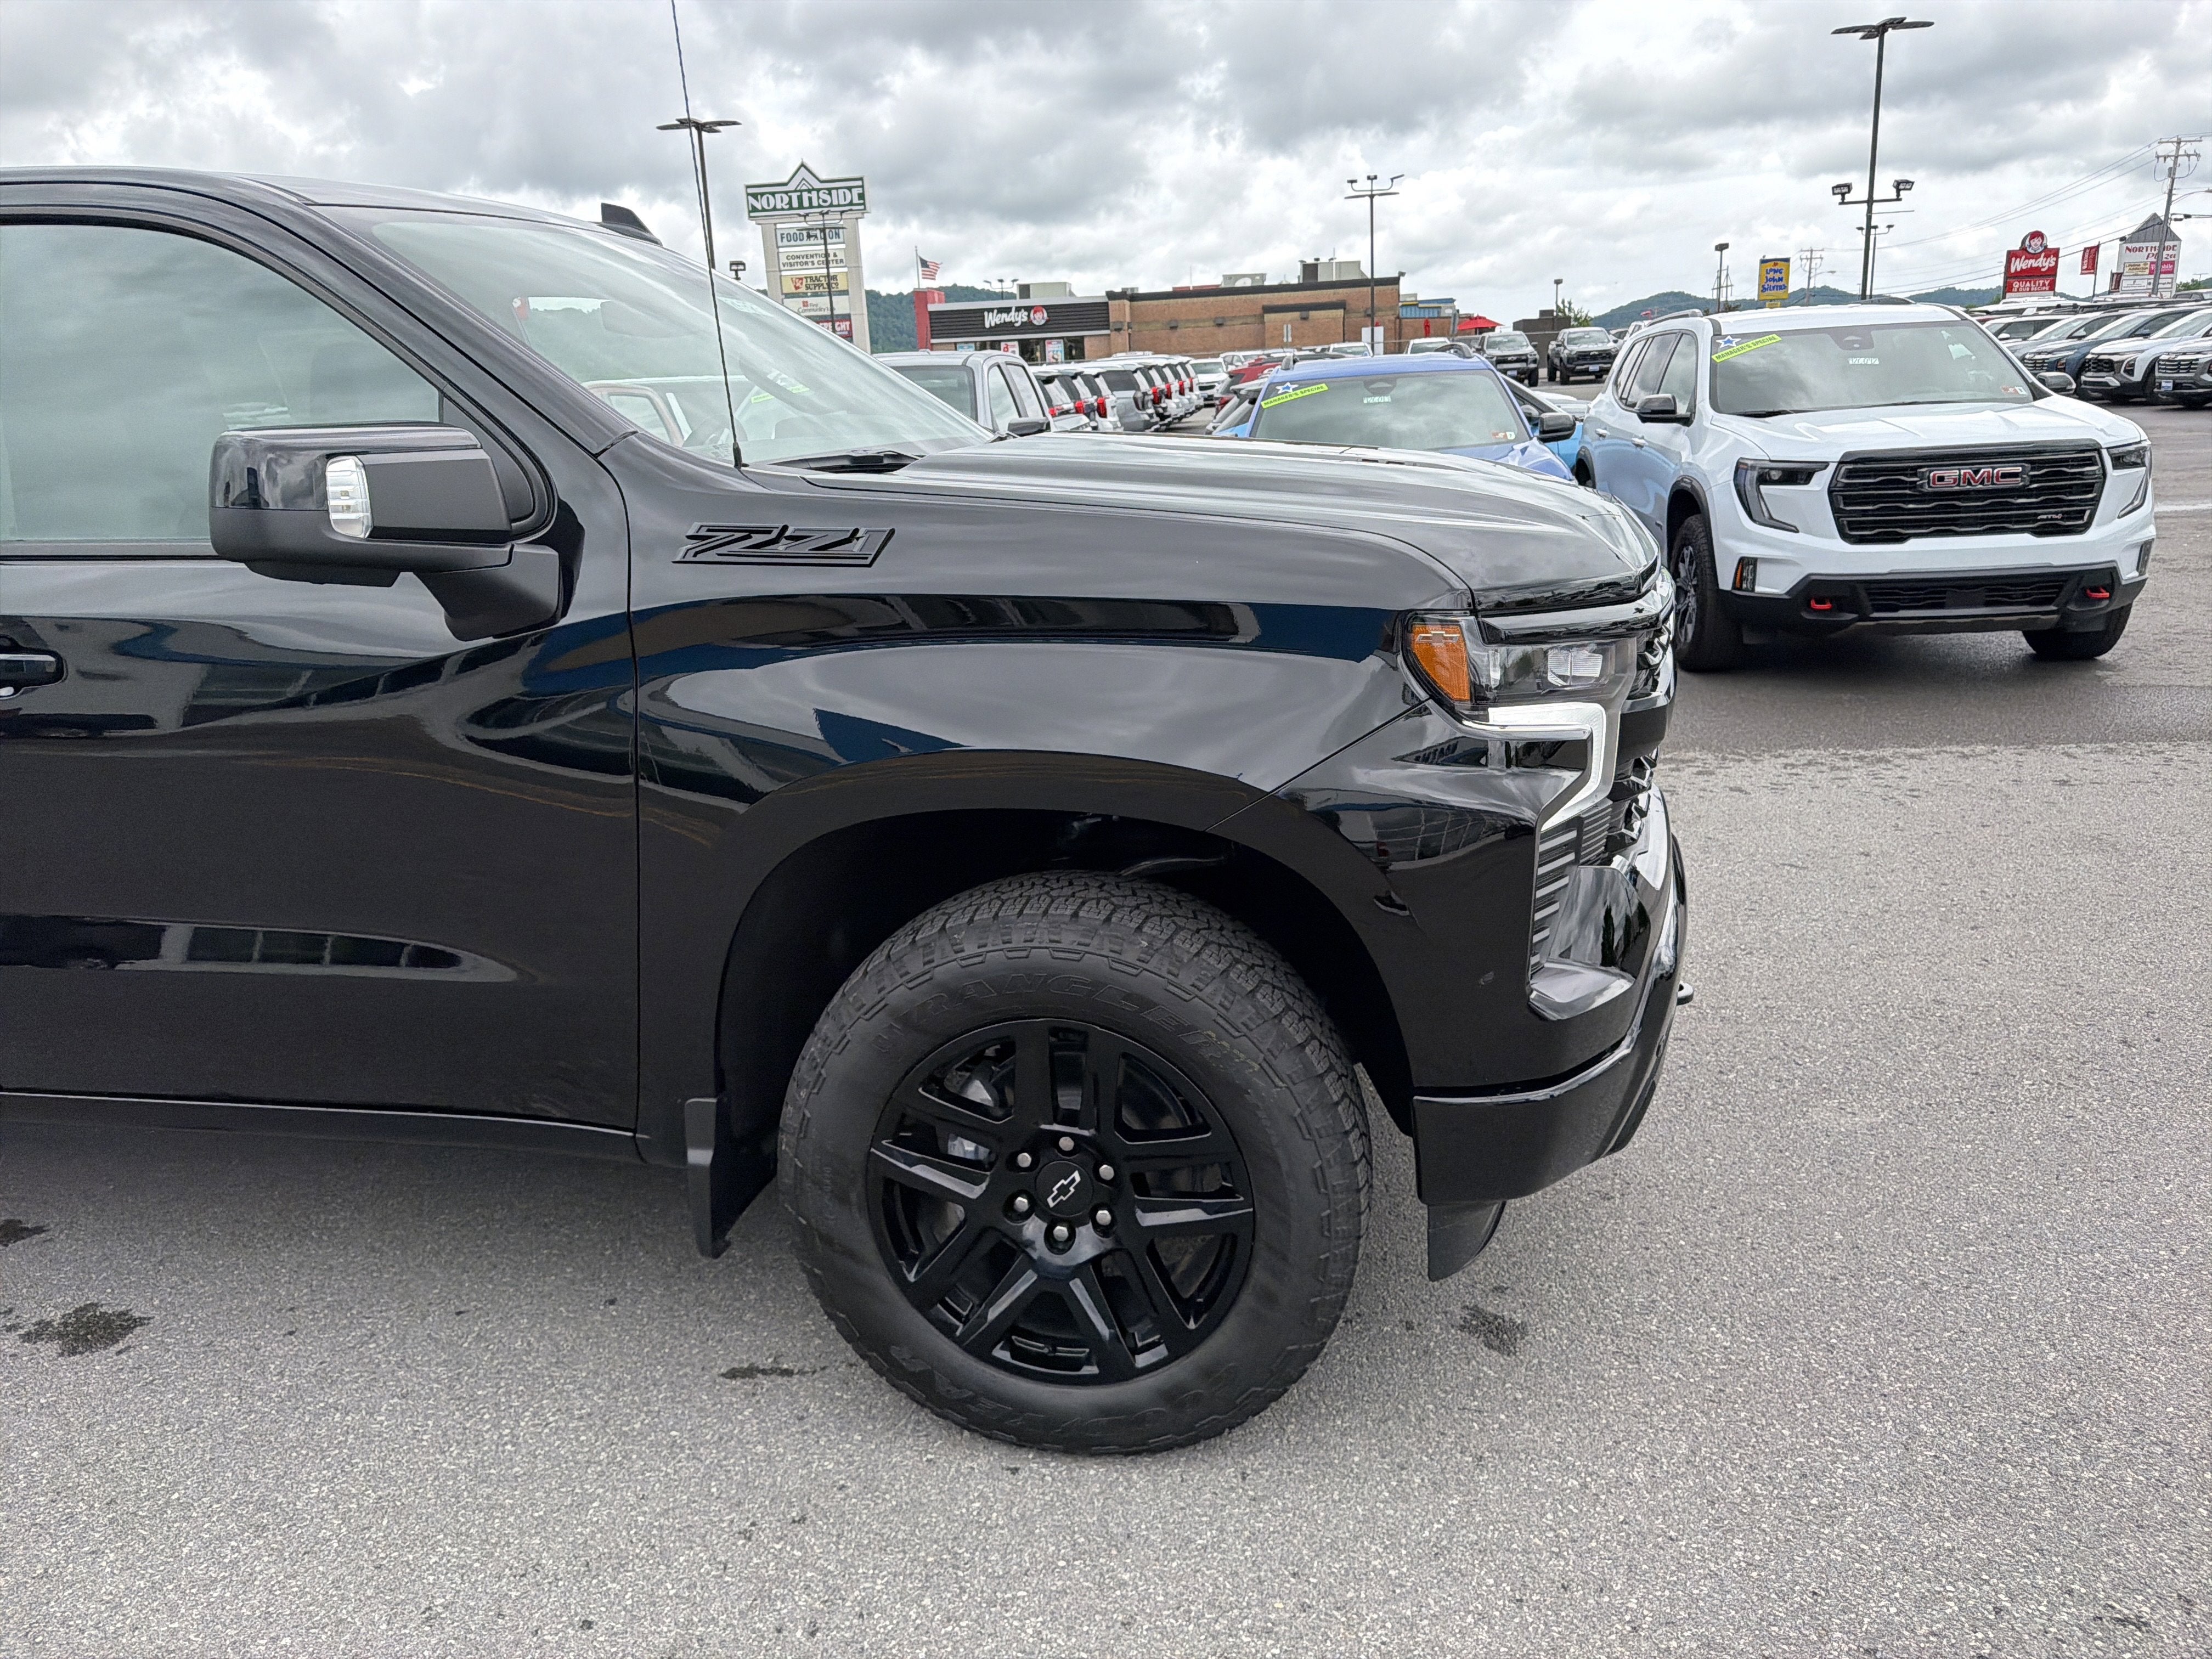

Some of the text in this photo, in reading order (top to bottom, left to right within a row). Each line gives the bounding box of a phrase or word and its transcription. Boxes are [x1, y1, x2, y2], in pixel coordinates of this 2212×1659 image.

[748, 187, 864, 211] NORTHSIDE
[780, 229, 840, 242] FOOD LON
[2011, 252, 2056, 273] Wendy's
[2013, 280, 2050, 288] QUALITY
[984, 306, 1028, 328] Wendy's
[1716, 336, 1776, 360] MANAGER'S SPECIAL
[1263, 386, 1325, 406] MANAGER'S SPECIAL
[1930, 466, 2022, 487] GMC
[672, 521, 896, 568] Z71
